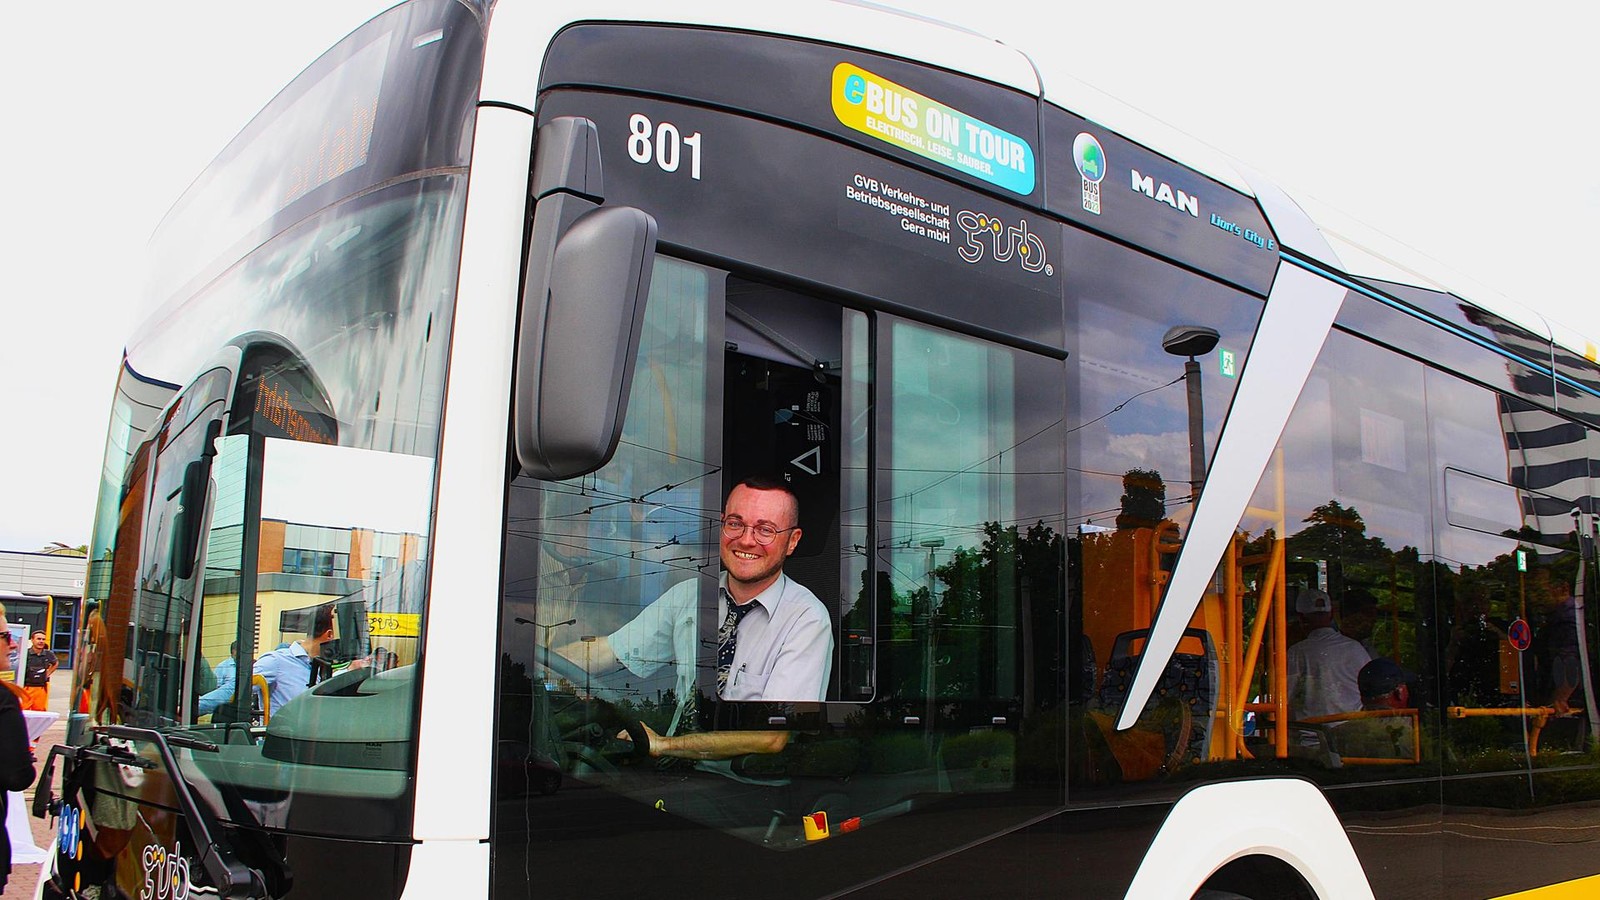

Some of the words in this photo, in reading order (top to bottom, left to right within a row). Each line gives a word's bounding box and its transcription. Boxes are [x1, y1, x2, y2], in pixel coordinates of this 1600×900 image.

[627, 113, 702, 180] 801
[843, 74, 919, 129] eBUS
[926, 107, 960, 146] ON
[965, 122, 1026, 174] TOUR
[866, 116, 925, 149] ELEKTRISCH.
[927, 141, 955, 161] LEISE.
[956, 153, 994, 176] SAUBER.
[846, 186, 951, 231] Betriebsgesellschaft
[854, 174, 879, 193] GVB
[880, 182, 930, 209] Verkehrs-
[930, 202, 951, 217] und
[1083, 179, 1099, 196] BUS
[1130, 169, 1200, 218] MAN
[901, 217, 926, 237] Gera
[926, 229, 951, 245] mbH
[1210, 213, 1242, 237] Lion's
[1244, 229, 1265, 250] City
[1267, 239, 1275, 251] E
